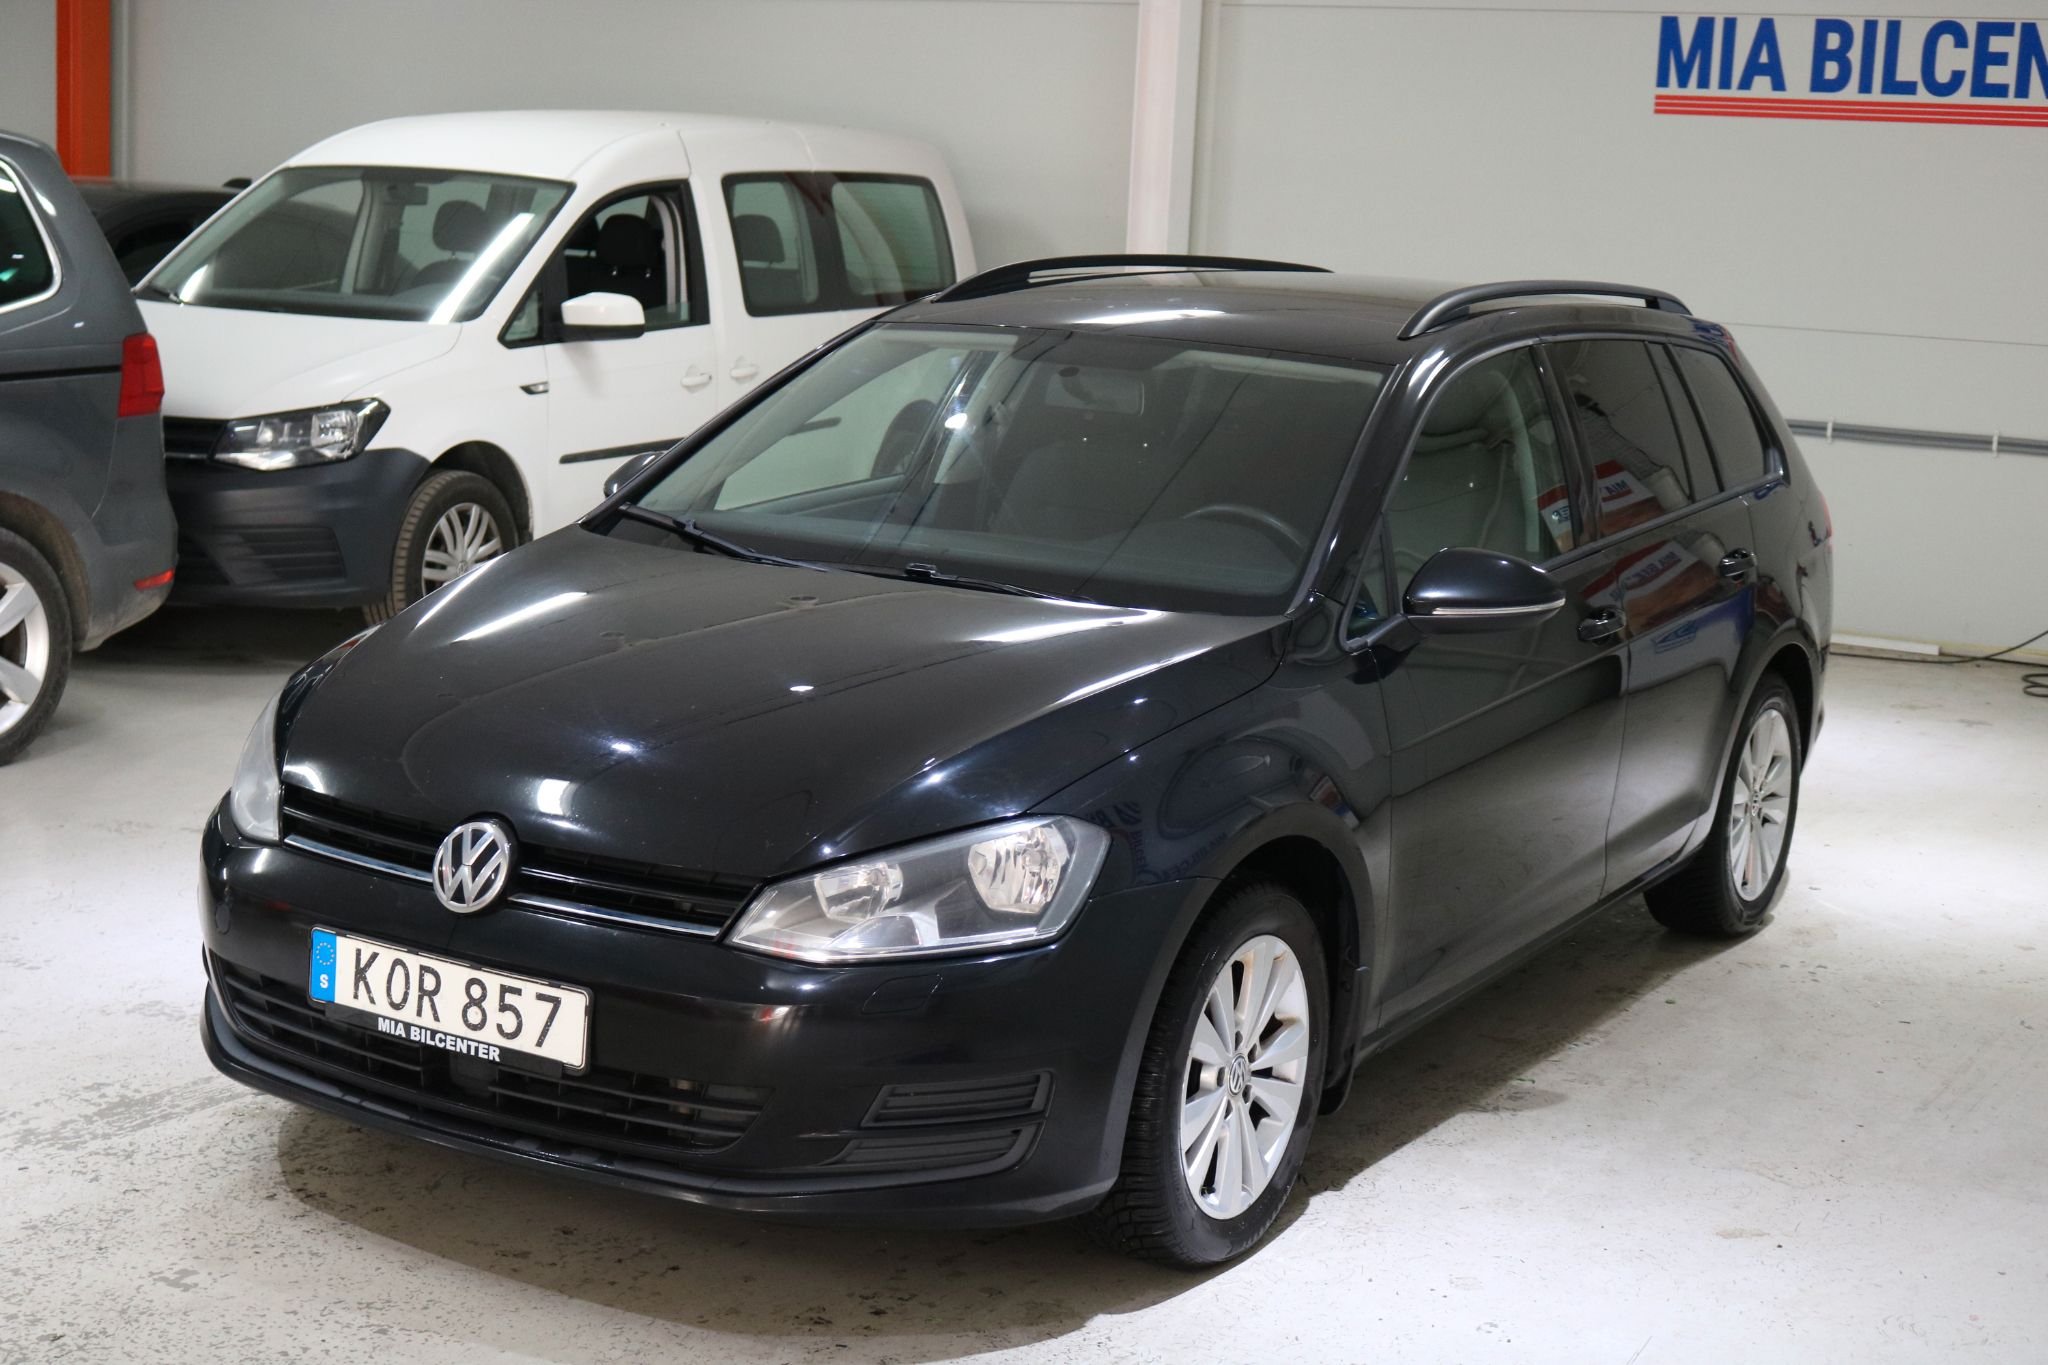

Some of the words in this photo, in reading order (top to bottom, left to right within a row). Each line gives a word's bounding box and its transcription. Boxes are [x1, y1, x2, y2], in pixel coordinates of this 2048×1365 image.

[1655, 15, 1787, 92] MIA
[433, 822, 509, 913] VW
[319, 973, 329, 989] S
[352, 948, 442, 1023] KOR
[461, 977, 562, 1048] 857
[377, 1017, 406, 1039] MIA
[410, 1024, 501, 1062] BILCENTER
